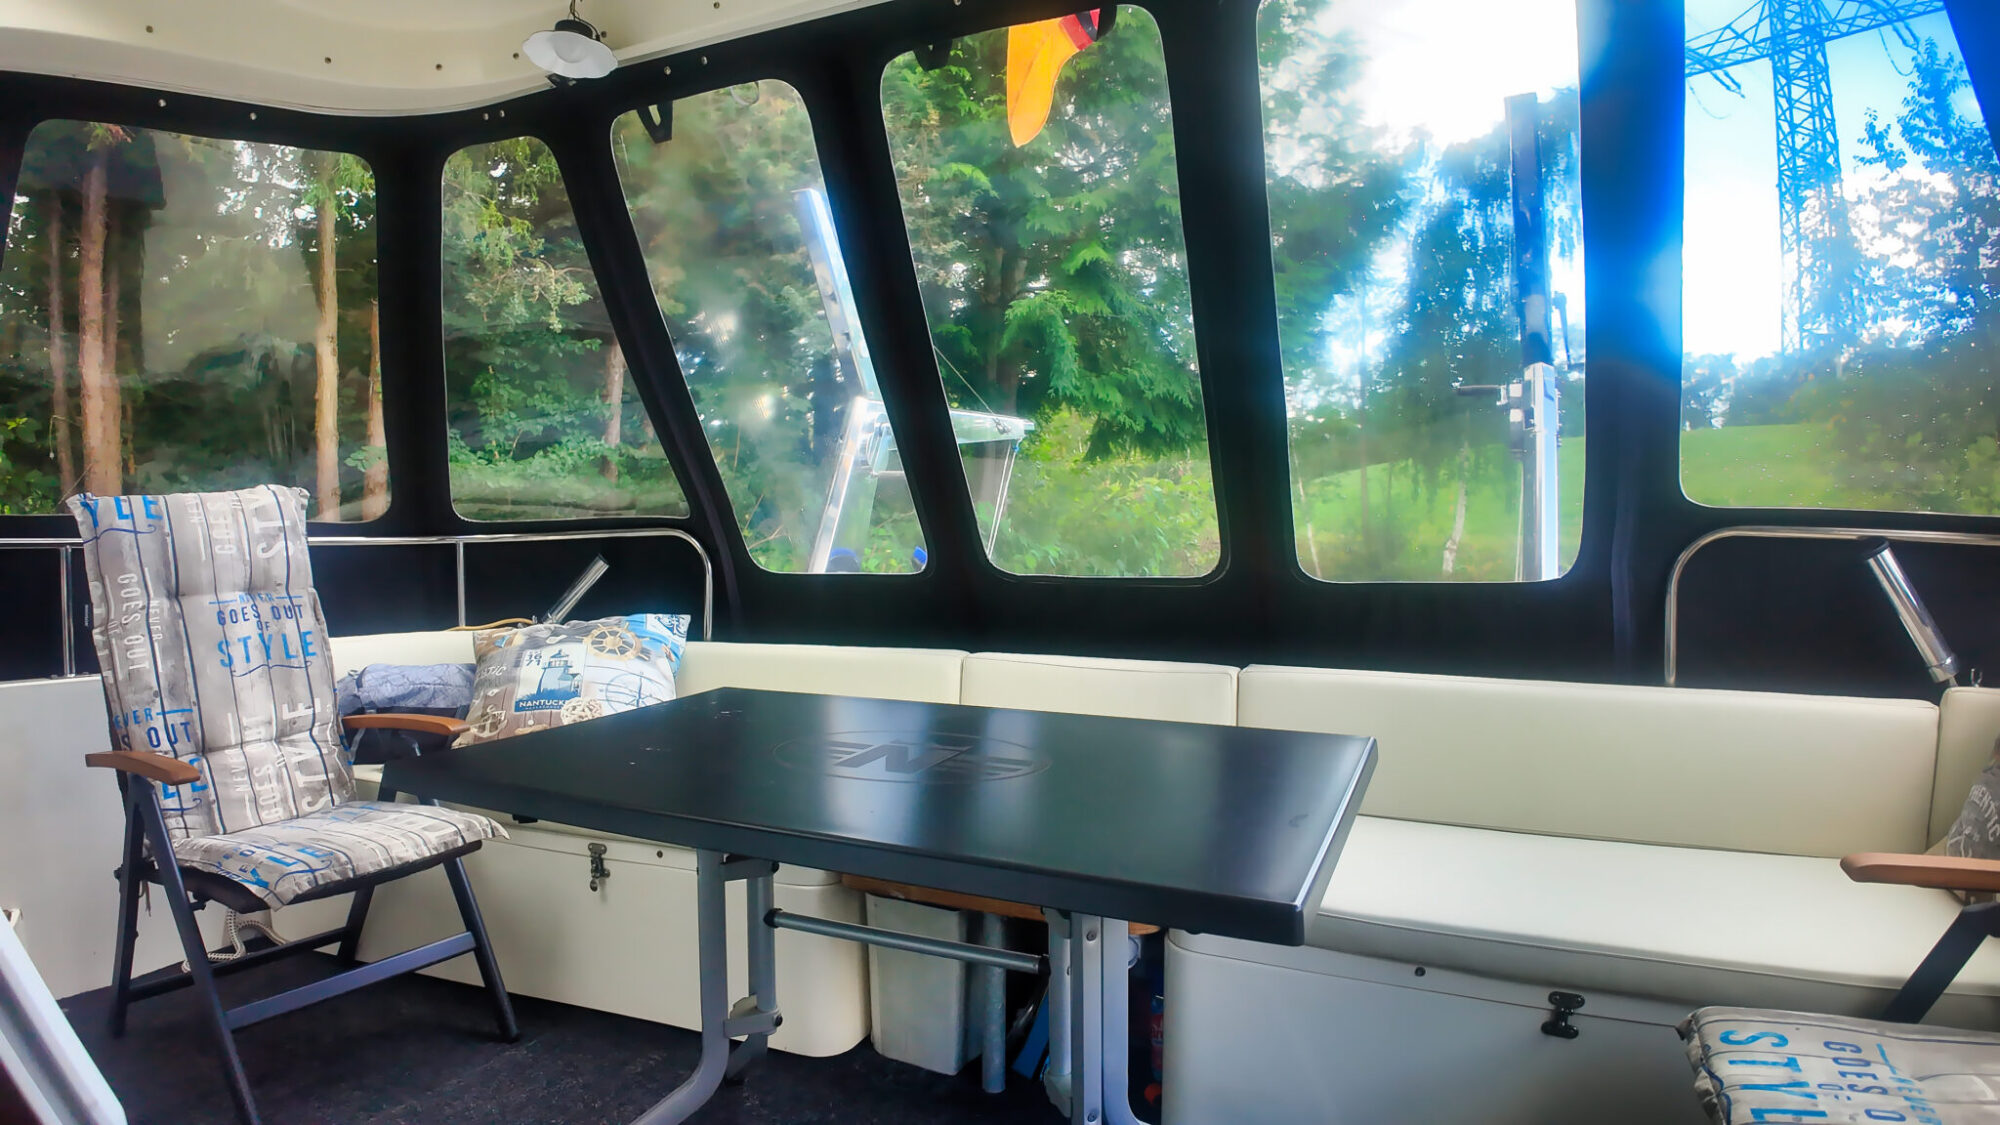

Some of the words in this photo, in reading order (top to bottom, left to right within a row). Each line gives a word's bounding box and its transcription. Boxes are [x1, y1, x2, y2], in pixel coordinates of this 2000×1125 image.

[117, 573, 144, 625] GOES
[216, 603, 261, 627] GOES
[270, 604, 303, 620] OUT
[256, 619, 271, 631] OF
[123, 634, 151, 670] OUT
[217, 630, 318, 668] STYLE
[519, 699, 567, 708] NANTUCK
[146, 721, 192, 748] OUT
[252, 764, 283, 819] GOES
[1822, 1040, 1889, 1095] GOES
